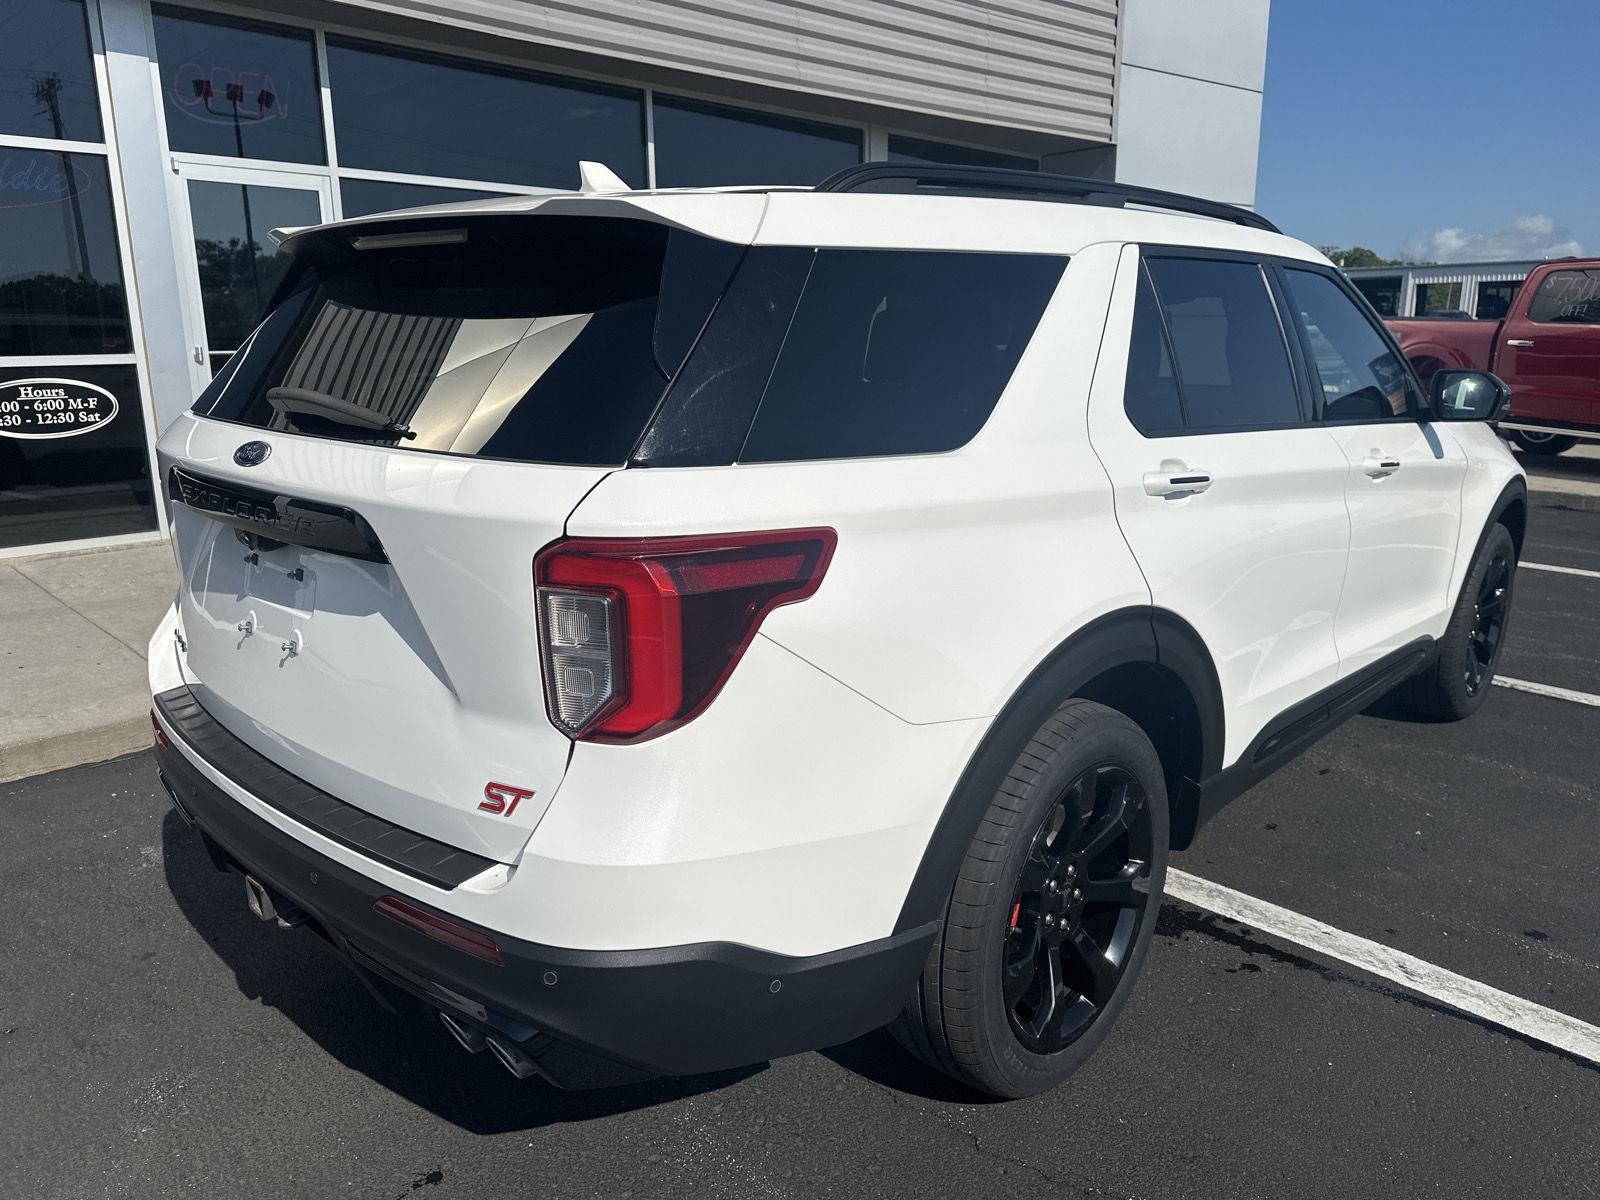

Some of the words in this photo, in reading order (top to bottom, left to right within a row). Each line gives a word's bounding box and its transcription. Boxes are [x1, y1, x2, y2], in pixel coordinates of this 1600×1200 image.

[173, 63, 291, 120] OPEN
[1560, 303, 1589, 317] OFF!
[18, 386, 66, 398] Hours
[33, 399, 65, 411] 6:00
[67, 397, 98, 410] M-F
[36, 412, 75, 425] 12:30
[78, 411, 101, 422] Sat
[182, 484, 317, 537] EXPLORER
[477, 781, 537, 818] ST
